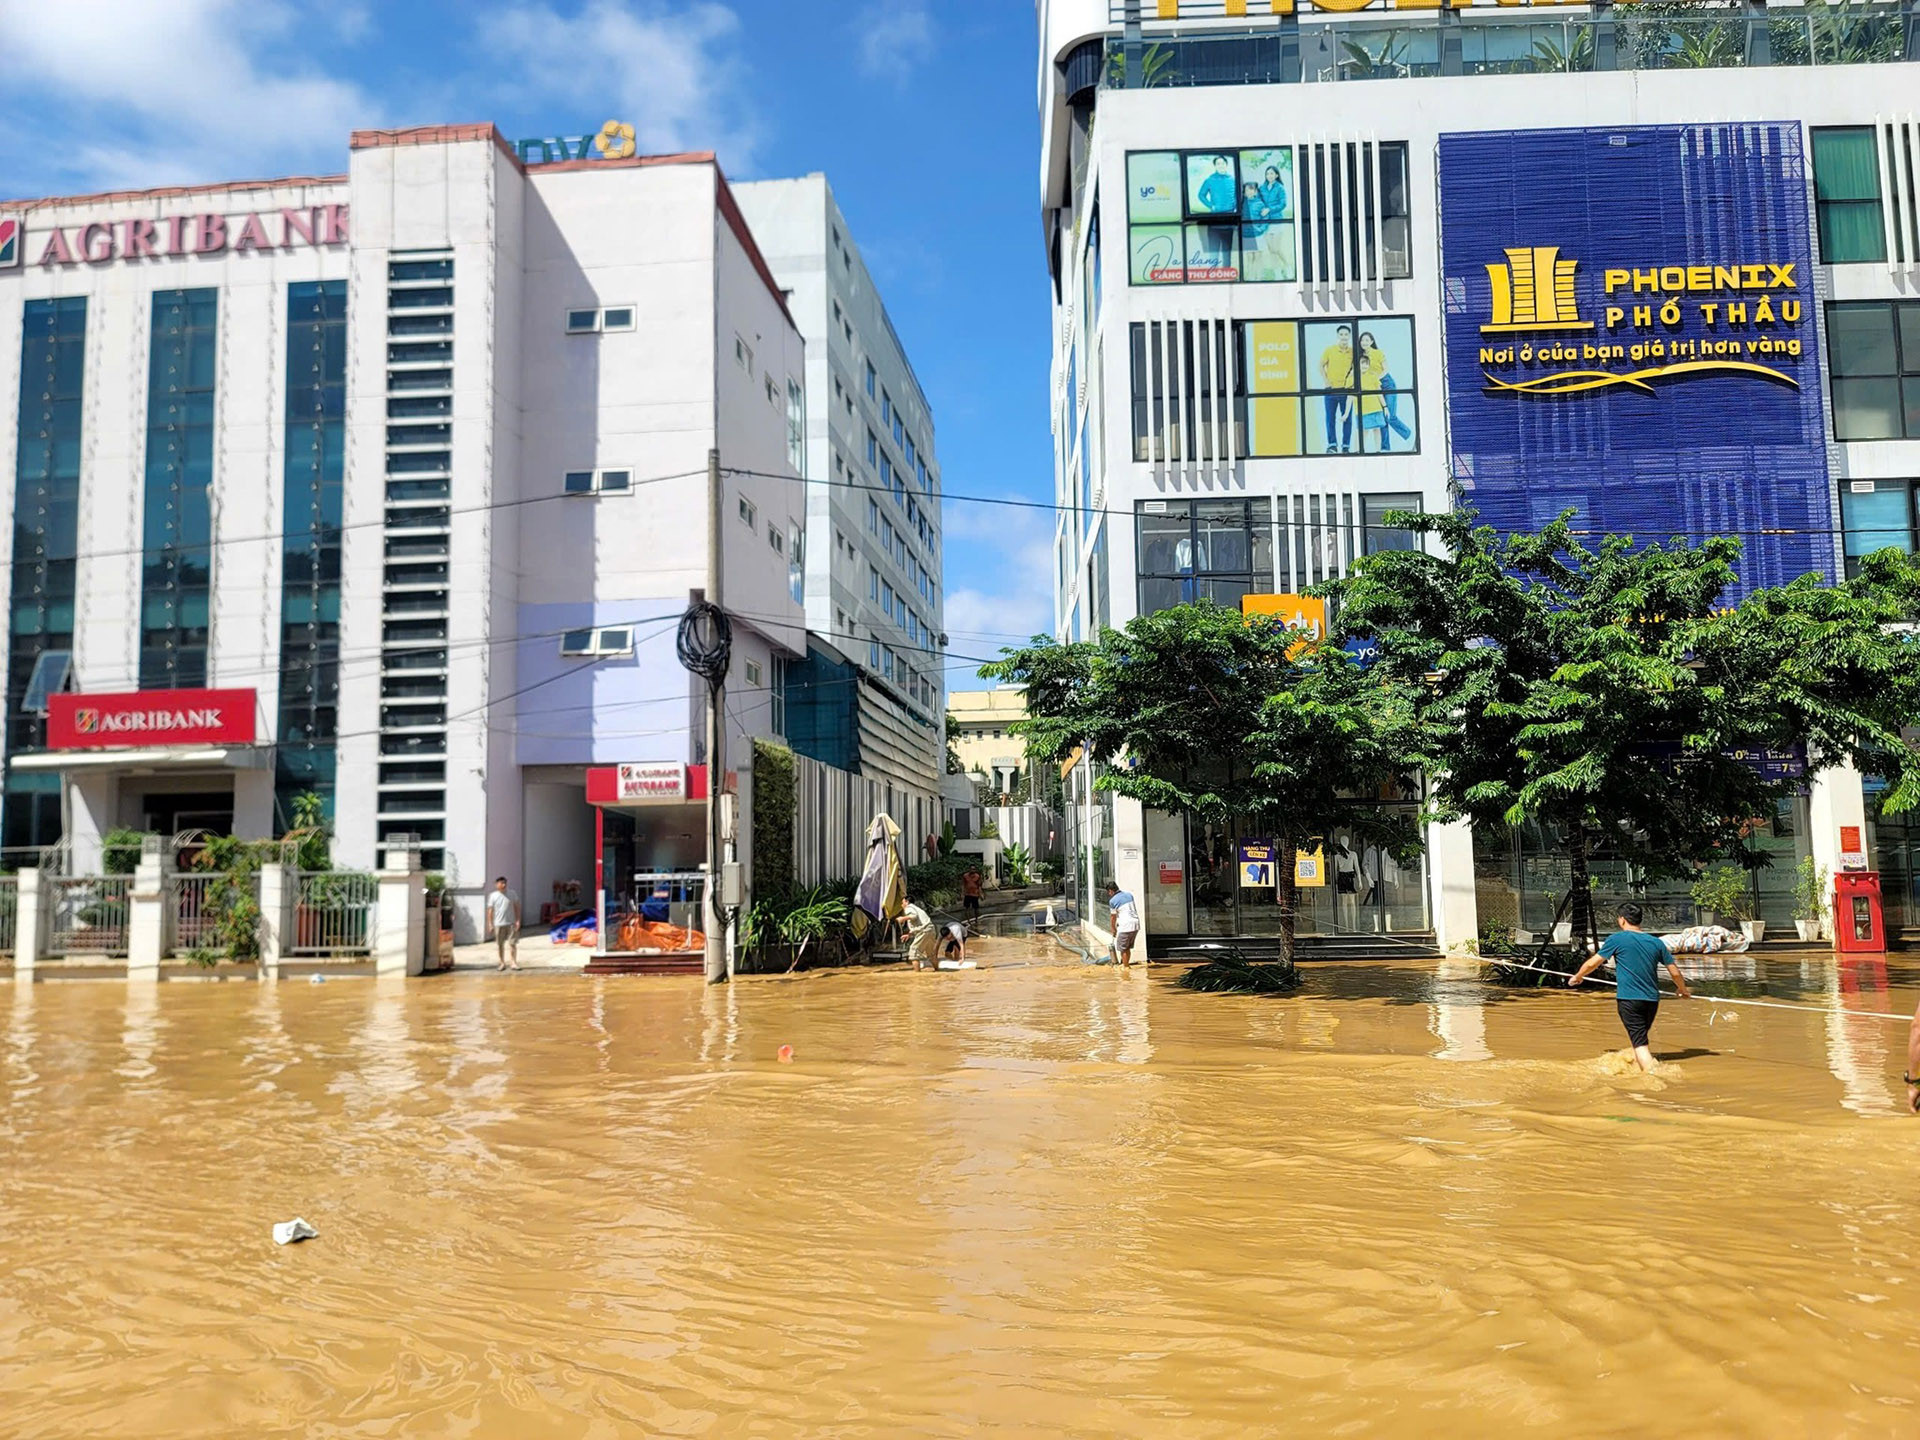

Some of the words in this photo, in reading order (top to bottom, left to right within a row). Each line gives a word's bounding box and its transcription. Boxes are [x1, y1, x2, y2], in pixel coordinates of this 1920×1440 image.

[38, 203, 349, 266] AGRIBANK
[1605, 264, 1796, 293] PHOENIX
[1607, 296, 1681, 327] PHỐ
[1700, 295, 1801, 324] THẦU
[1480, 345, 1514, 363] Nơi
[1519, 343, 1533, 361] ở
[1538, 342, 1577, 360] của
[1583, 343, 1624, 363] bạn
[1631, 337, 1664, 361] giá
[1671, 339, 1695, 360] trị
[1701, 340, 1741, 355] hơn
[1745, 335, 1801, 356] vàng
[101, 708, 224, 733] AGRIBANK
